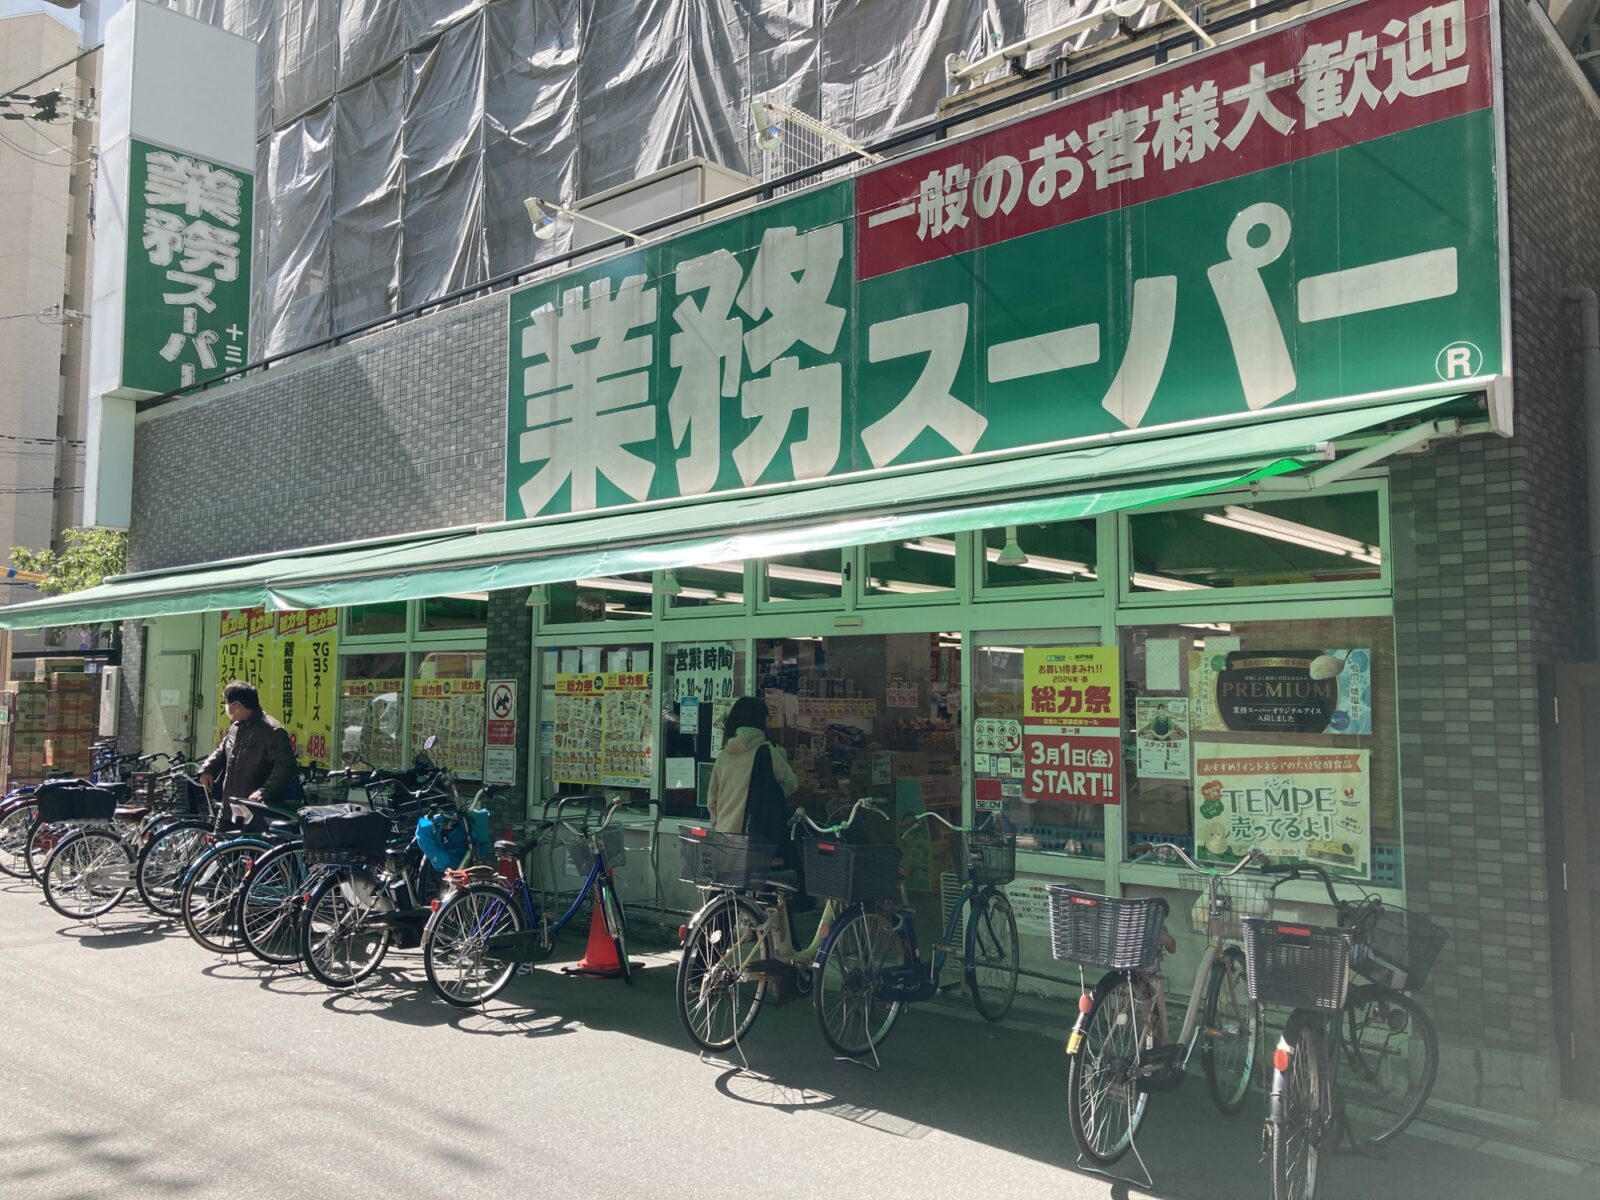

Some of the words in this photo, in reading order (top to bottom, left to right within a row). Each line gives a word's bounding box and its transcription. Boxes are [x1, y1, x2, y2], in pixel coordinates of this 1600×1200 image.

[868, 6, 1470, 242] 一般のお客様大歓迎
[144, 151, 243, 389] 業務スーパー
[518, 202, 1457, 518] 業務スーパー
[676, 647, 733, 671] 営業時間
[1038, 664, 1103, 674] お買い得まみれ!!
[312, 643, 322, 721] マヨネーズ
[1222, 682, 1332, 698] PREMIUM
[1031, 685, 1112, 714] 総力祭
[1233, 706, 1322, 715] 業務スーパーオリジナルアイス
[1257, 714, 1295, 723] 入荷しました
[306, 732, 326, 759] 488
[1031, 741, 1113, 768] 3月1日(金)
[1032, 770, 1113, 798] START!!
[976, 801, 1001, 809] SECOM
[1223, 786, 1334, 814] TEMPE
[1232, 816, 1331, 840] 売ってるよ!
